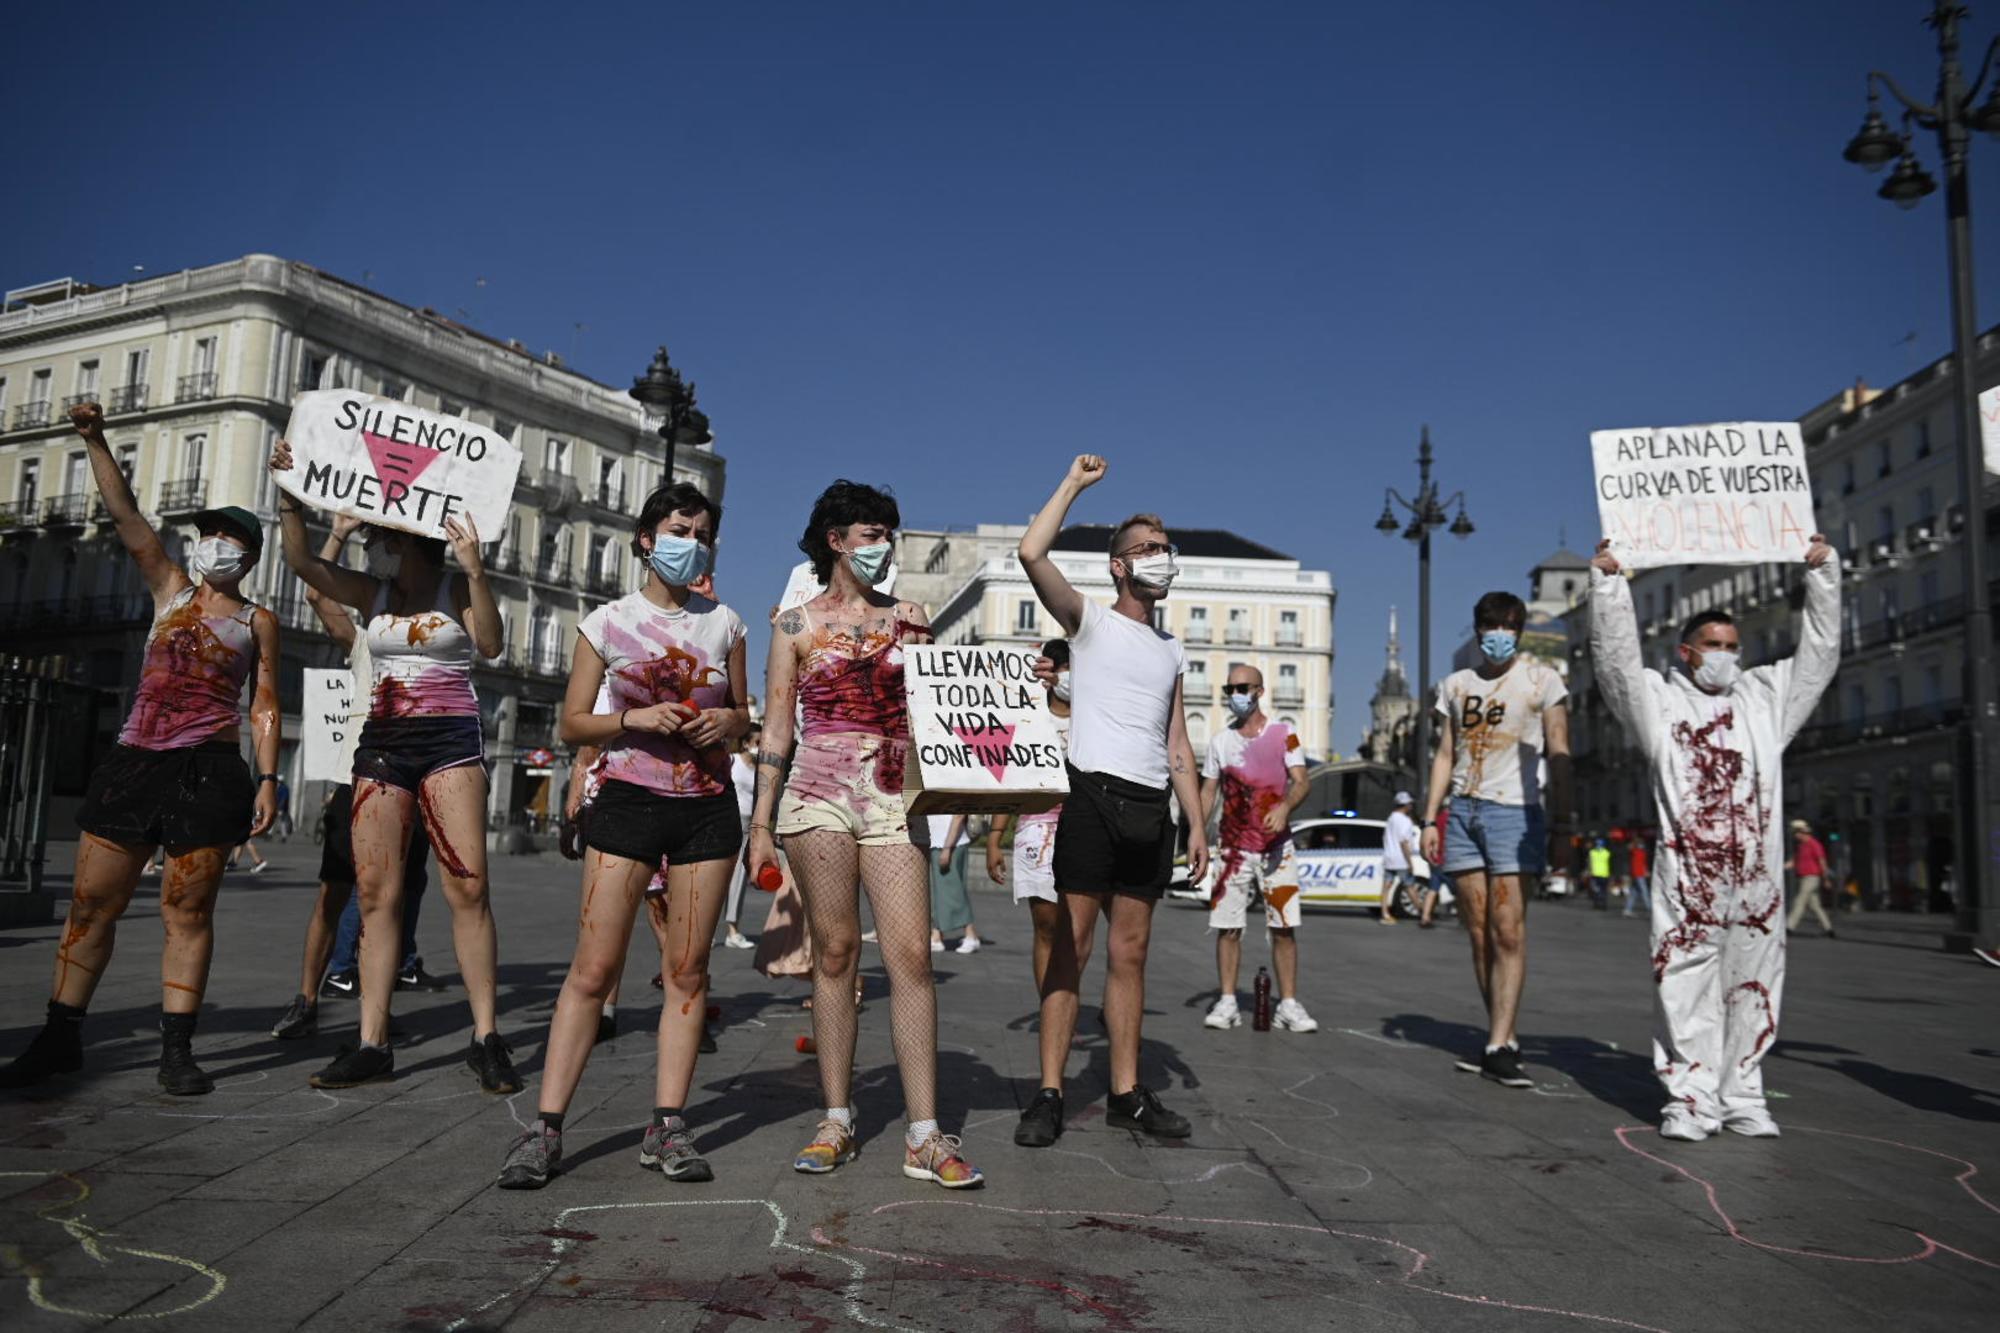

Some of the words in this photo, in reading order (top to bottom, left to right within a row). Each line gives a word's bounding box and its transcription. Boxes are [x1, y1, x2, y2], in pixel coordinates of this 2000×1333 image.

[334, 400, 487, 462] SILENCIO
[1617, 429, 1746, 461] APLANAD
[1758, 429, 1793, 457] LA
[303, 460, 463, 527] MUERTE
[1600, 470, 1683, 501] CURVA
[1686, 465, 1716, 494] DE
[1719, 463, 1808, 494] VUESTRA
[1613, 500, 1806, 551] VIOLENCIA
[915, 649, 1041, 683] LLEVAMOS
[326, 678, 345, 689] LA
[929, 684, 1000, 708] TODA
[1002, 684, 1037, 710] LA
[935, 712, 1010, 737] VIDA
[1461, 695, 1506, 728] Be
[920, 743, 1061, 769] CONFINADES
